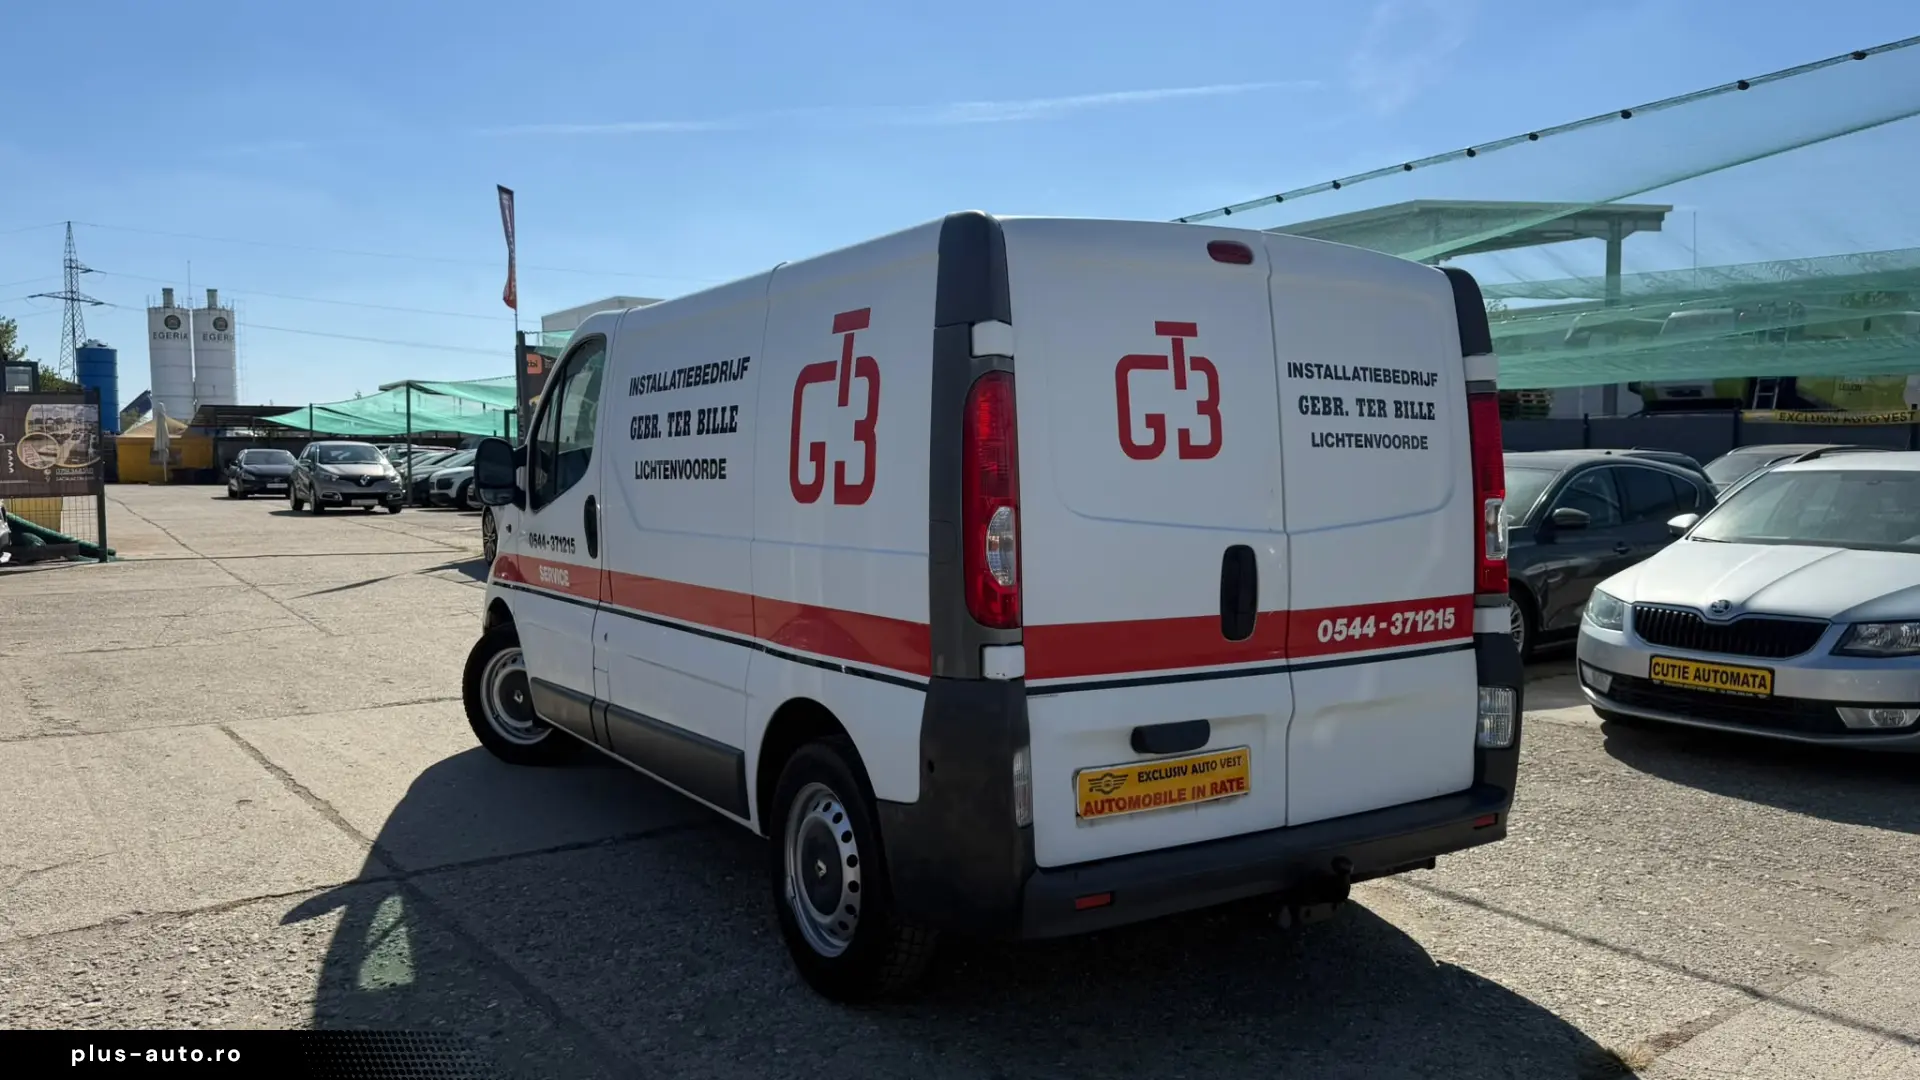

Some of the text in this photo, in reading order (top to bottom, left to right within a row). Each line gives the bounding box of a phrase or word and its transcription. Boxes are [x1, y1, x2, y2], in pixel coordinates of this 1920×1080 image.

[152, 331, 188, 340] EGERIA
[629, 356, 750, 396] INSTALLATIEBEDRIJF
[1287, 361, 1438, 387] INSTALLATIEBEDRIJF
[1298, 395, 1435, 420] GEBR. TER BILLE
[1778, 412, 1838, 423] EXCLUSIV
[1883, 411, 1916, 422] VEST
[630, 405, 738, 440] GEBR. TER BILLE
[1311, 432, 1428, 450] LICHTENVOORDE
[635, 458, 727, 480] LICHTENVOORDE
[539, 565, 570, 587] SERVICE
[1317, 607, 1455, 643] 0544-371215
[1652, 662, 1689, 680] CUTIE
[1693, 667, 1767, 690] AUTOMATA
[1137, 755, 1242, 783] EXCLUSIV AUTO VEST
[1083, 777, 1245, 816] AUTOMOBILE IN RATE
